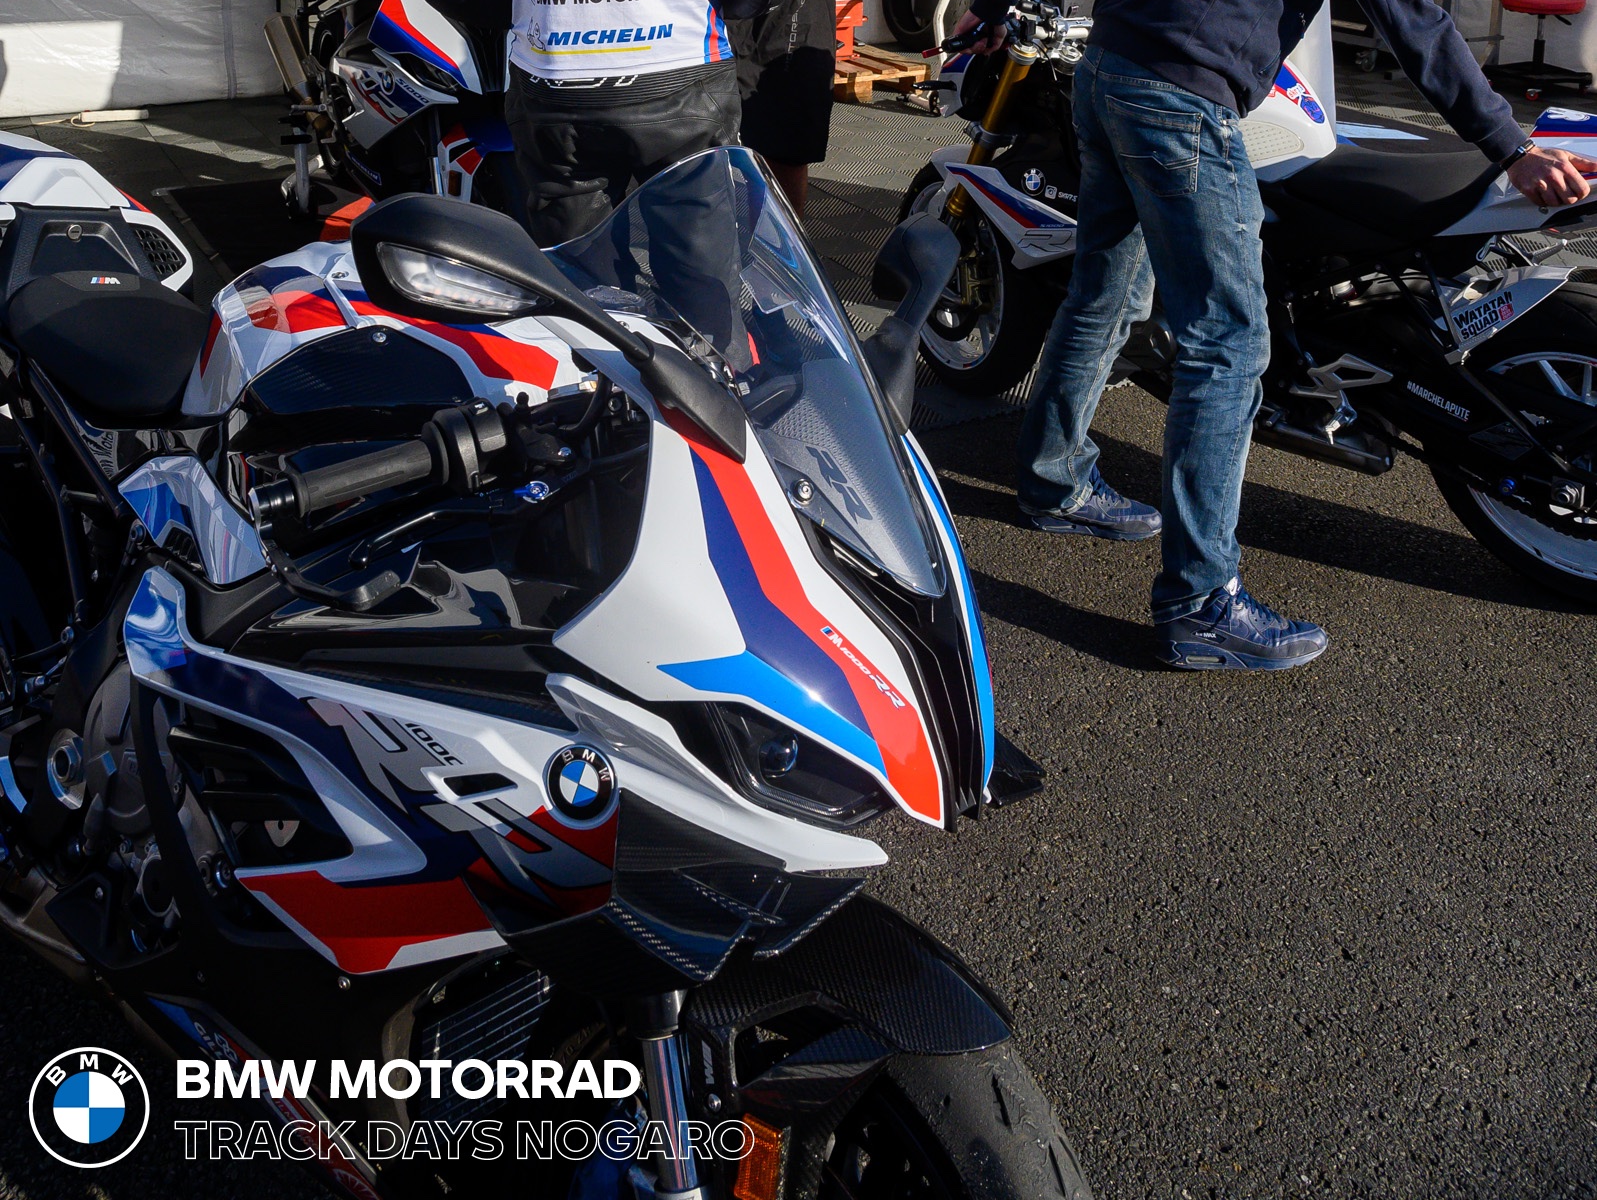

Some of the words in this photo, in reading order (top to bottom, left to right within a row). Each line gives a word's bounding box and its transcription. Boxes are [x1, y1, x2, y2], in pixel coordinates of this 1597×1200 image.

[547, 23, 674, 46] MICHELIN
[1461, 309, 1500, 340] SQUAD
[1406, 380, 1471, 420] #MARCHELAPUTE
[840, 647, 872, 675] 1000
[868, 674, 906, 710] RR
[561, 748, 610, 783] BMW
